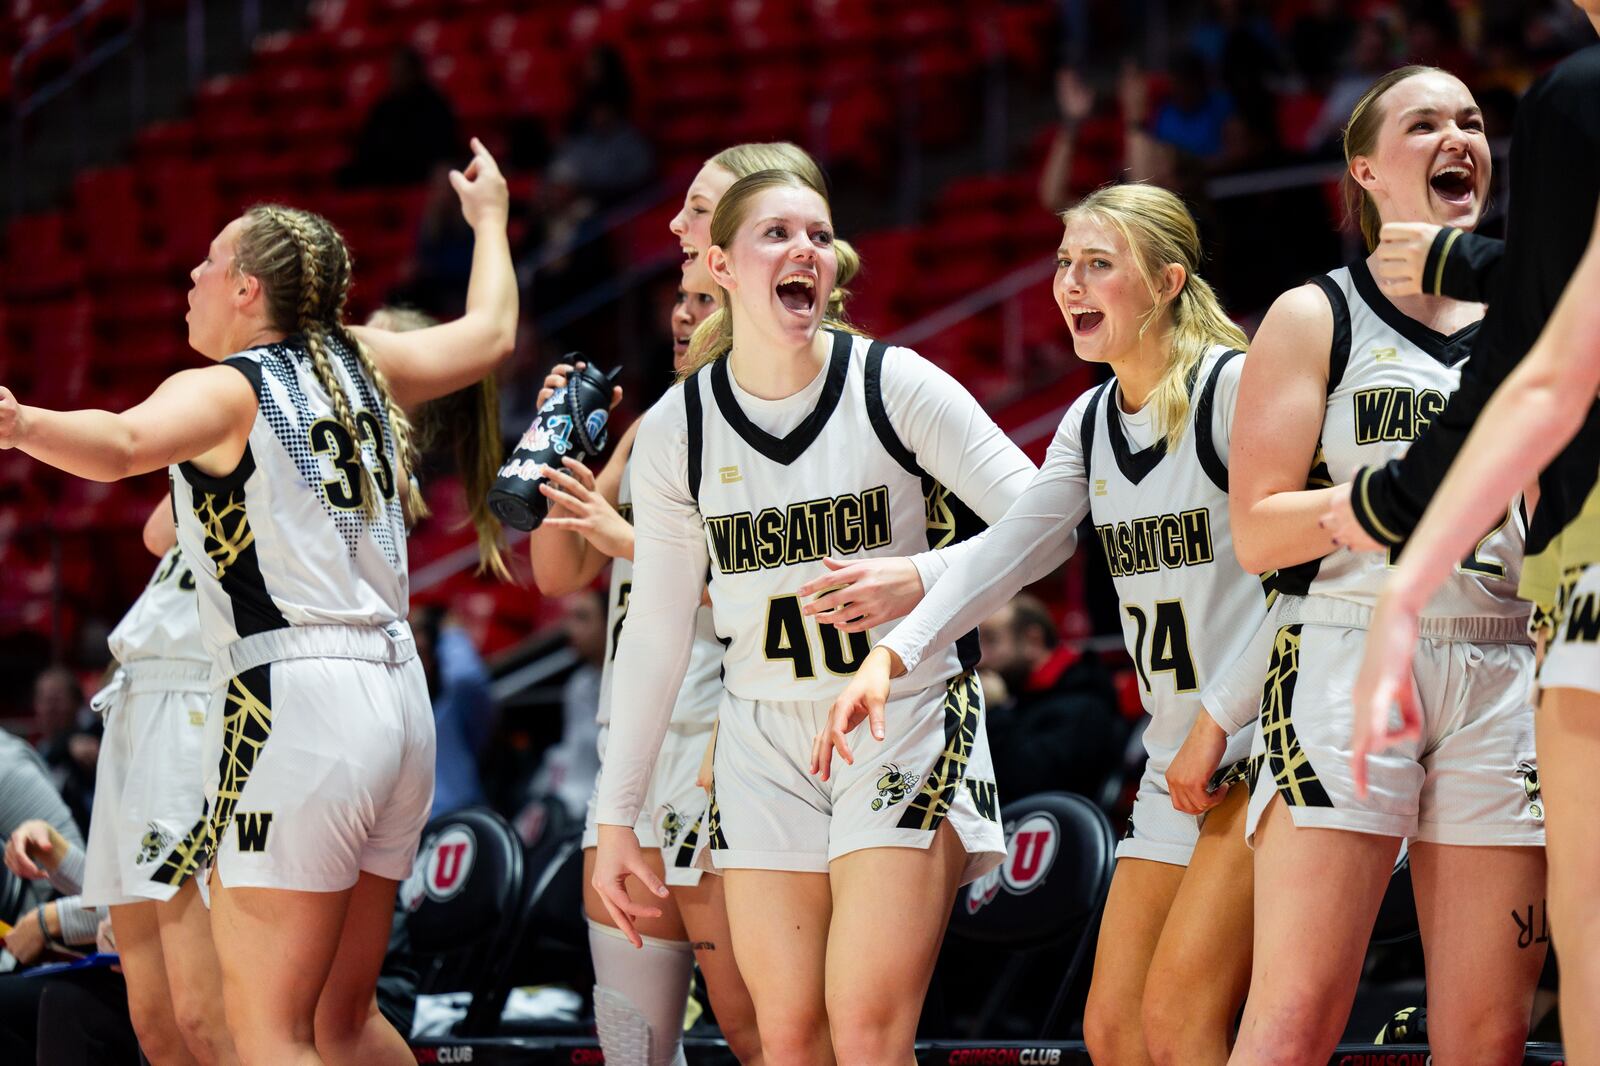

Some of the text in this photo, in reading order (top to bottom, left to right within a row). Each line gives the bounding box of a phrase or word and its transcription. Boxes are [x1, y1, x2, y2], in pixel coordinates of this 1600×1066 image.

[309, 409, 396, 512] 33
[706, 484, 892, 575] WASATCH
[1095, 507, 1215, 577] ASATCH
[762, 583, 874, 681] 40
[965, 778, 998, 823] W
[234, 811, 273, 853] W
[1010, 831, 1051, 883] U
[434, 842, 468, 890] U
